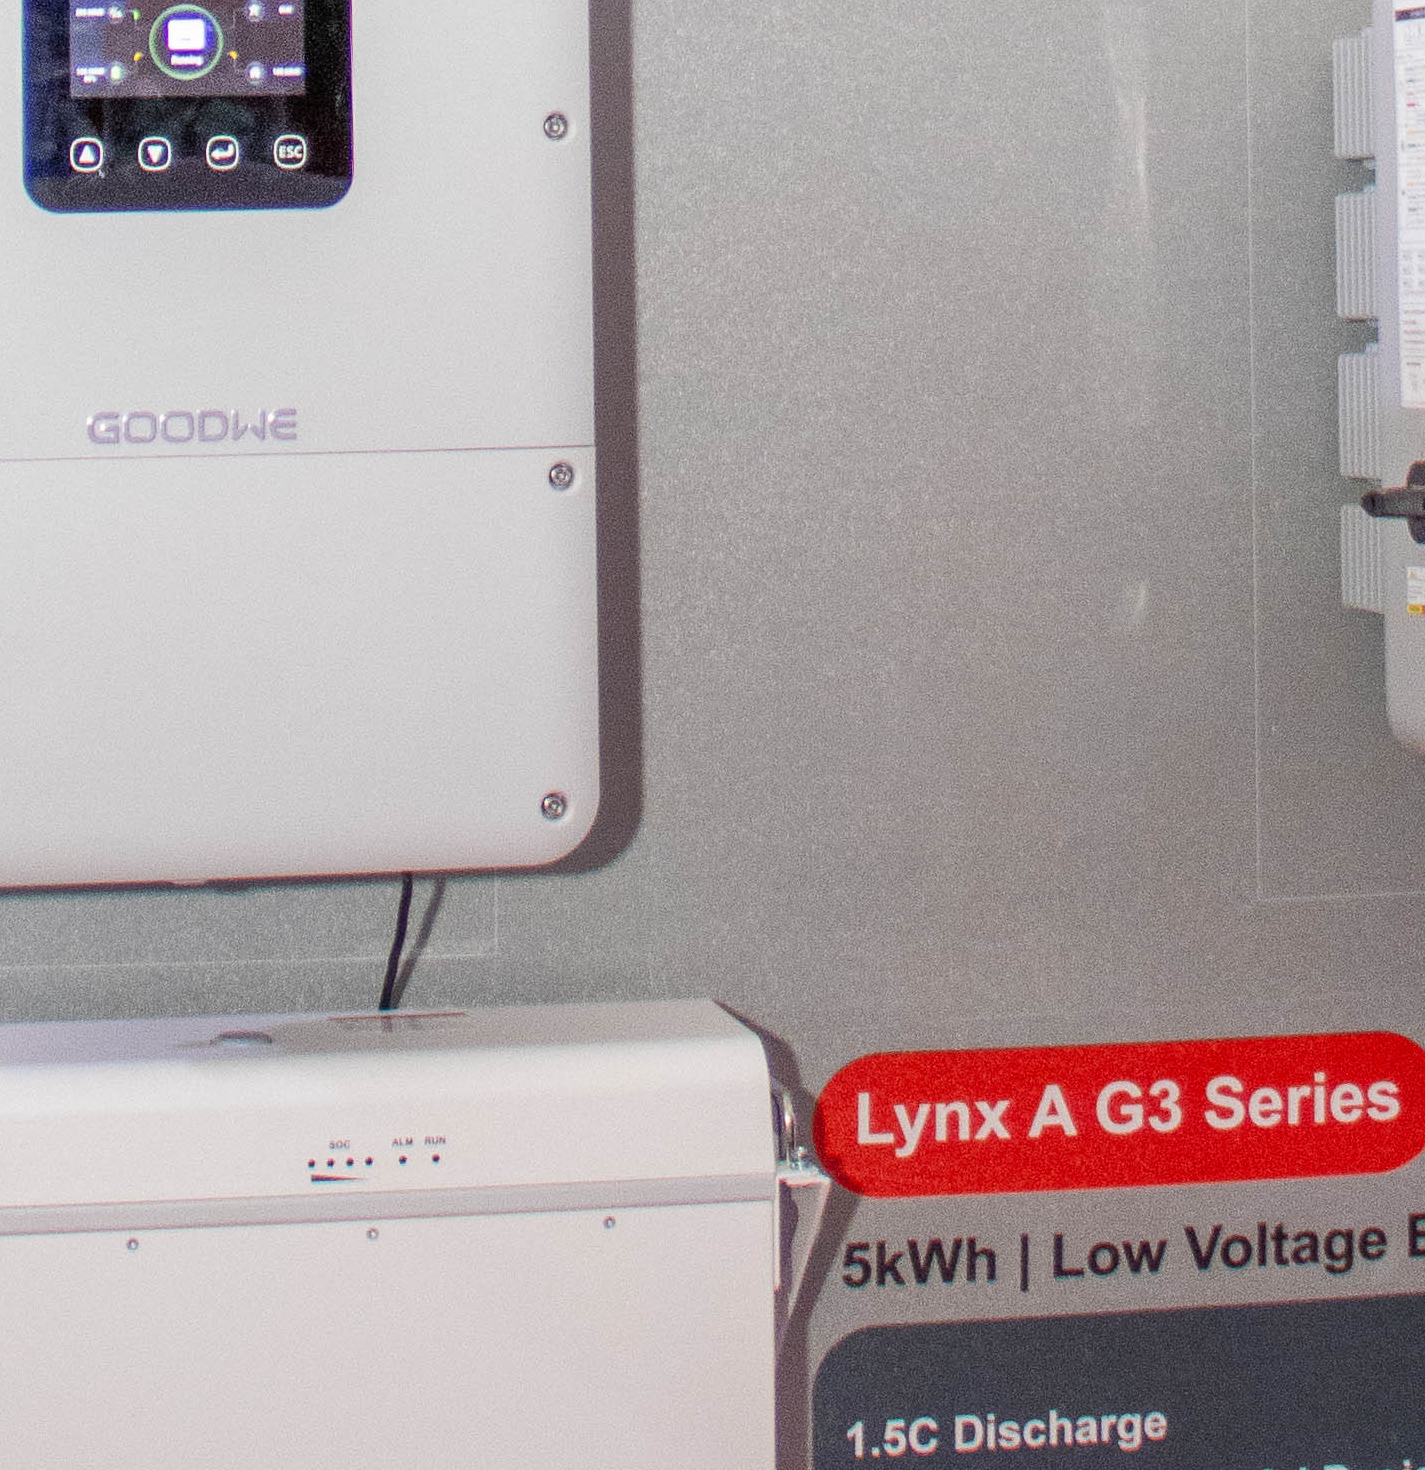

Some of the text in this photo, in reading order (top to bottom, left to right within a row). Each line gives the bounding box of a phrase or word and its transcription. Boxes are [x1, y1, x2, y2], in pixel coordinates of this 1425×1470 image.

[278, 144, 304, 160] ESC
[86, 407, 298, 445] GOODWE
[855, 1071, 1402, 1158] Lynx A G3 Series
[841, 1234, 998, 1289] 5kWh
[1053, 1233, 1168, 1281] Low
[1184, 1221, 1389, 1276] Voltage
[845, 1409, 1169, 1459] 1.5C Discharge
